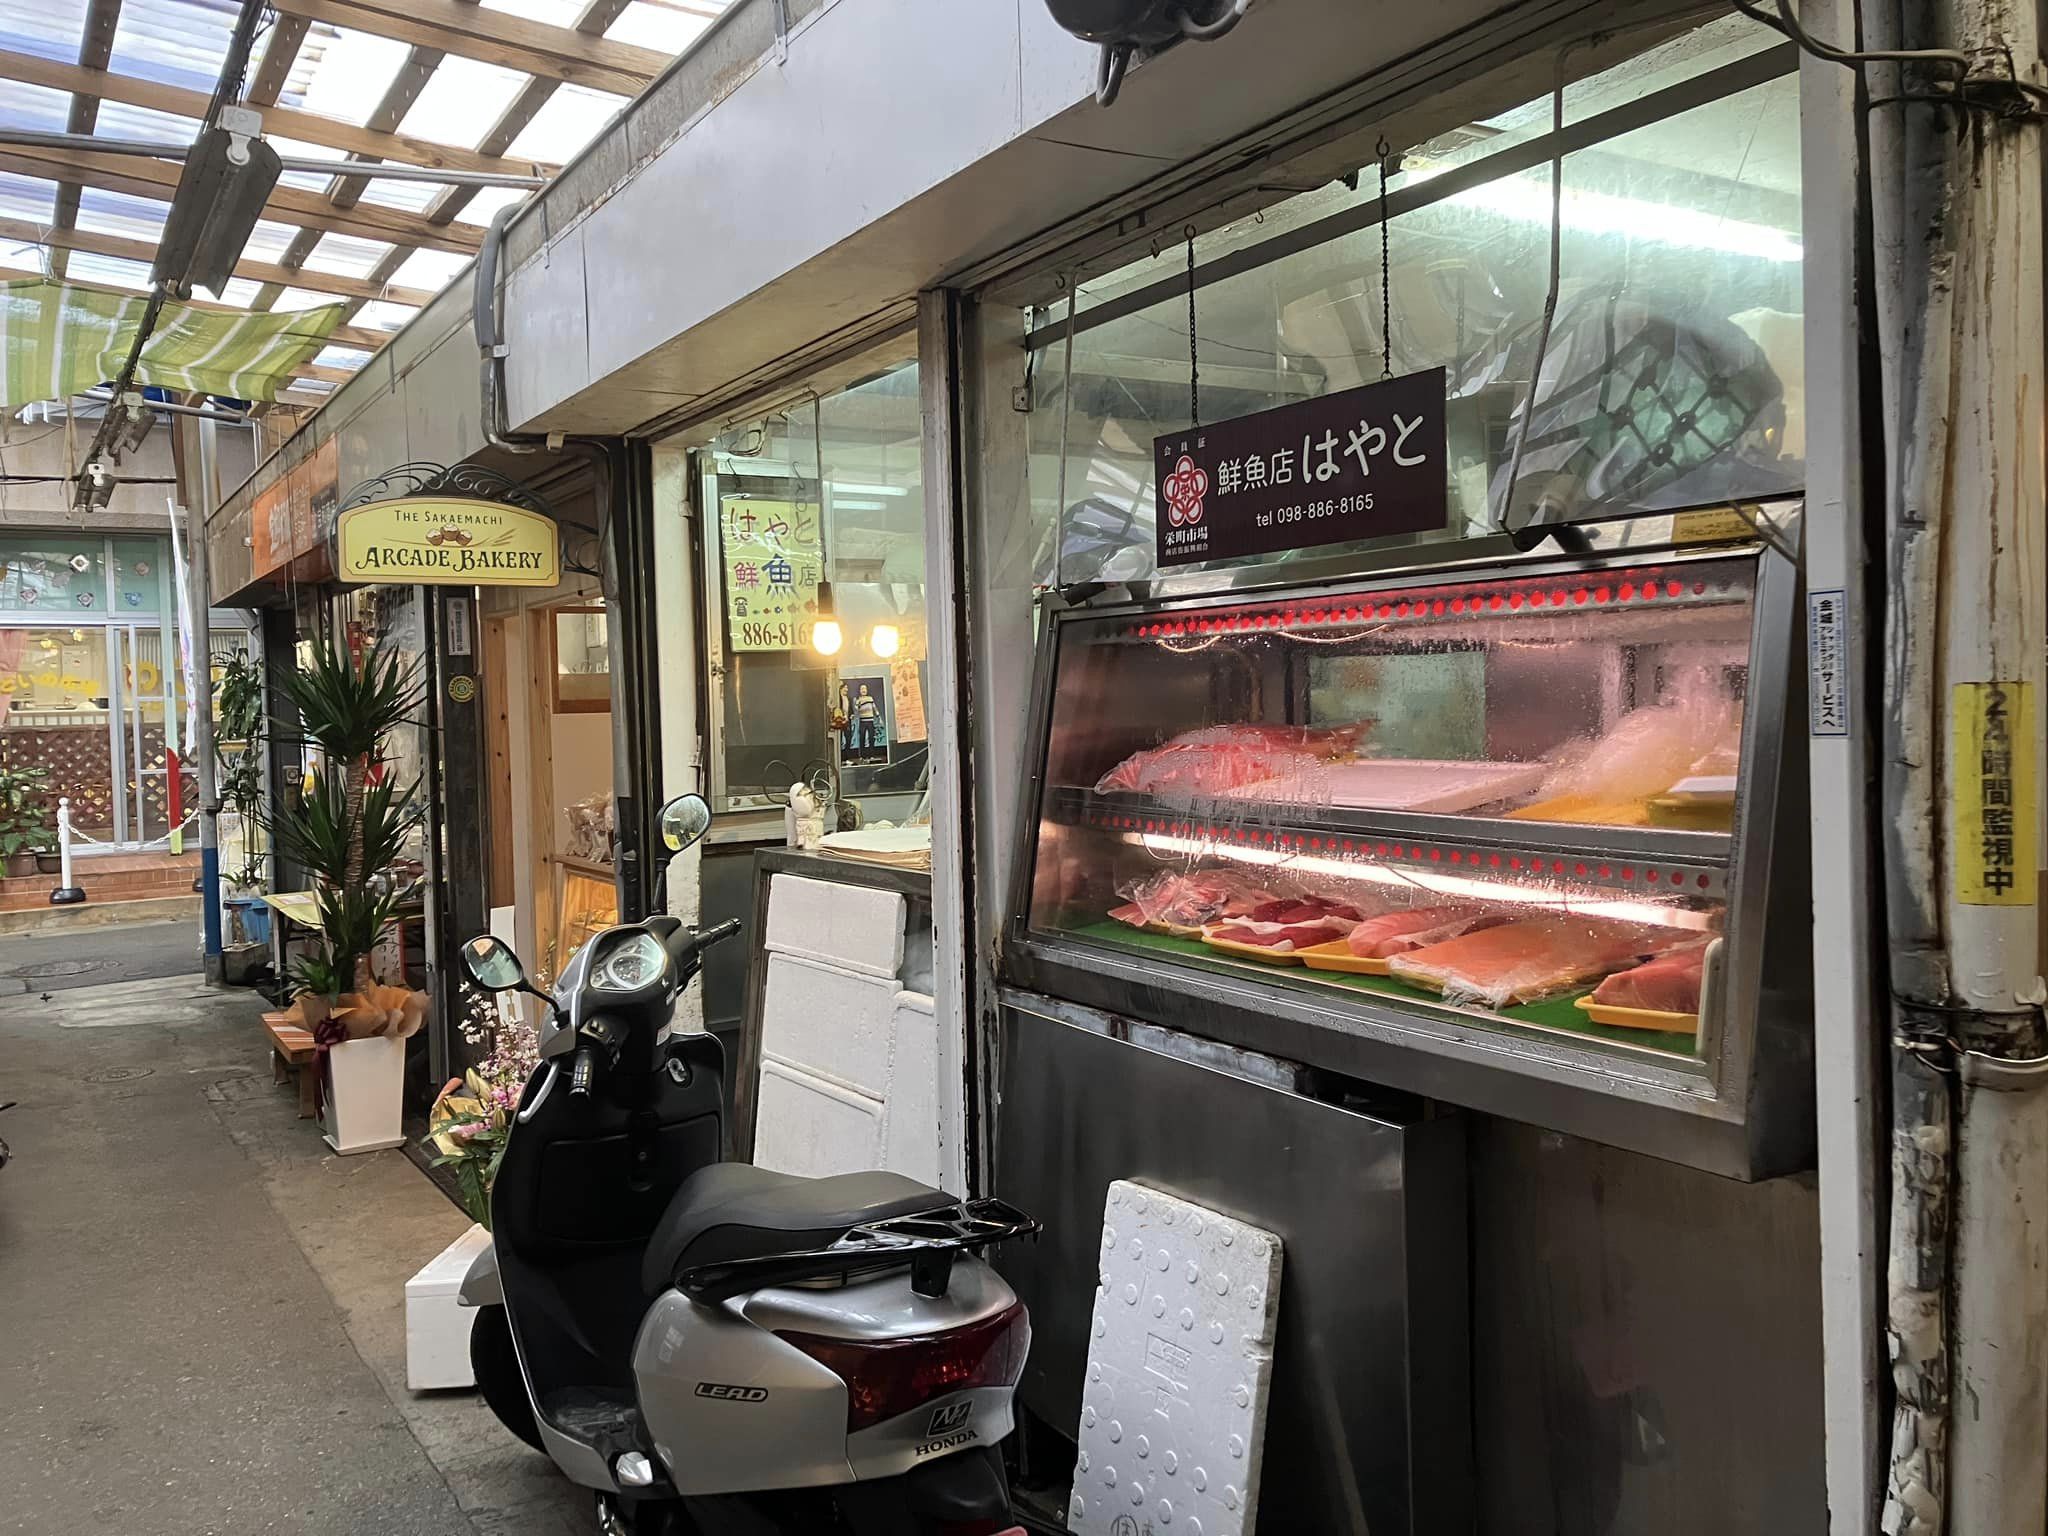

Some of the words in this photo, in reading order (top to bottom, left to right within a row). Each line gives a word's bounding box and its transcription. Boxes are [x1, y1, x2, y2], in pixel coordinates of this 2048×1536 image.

[1217, 447, 1294, 497] 鮮魚店
[1303, 413, 1427, 484] はやと
[394, 509, 419, 522] THE
[424, 510, 503, 526] SAKAEMACHI
[1256, 510, 1273, 528] tel
[1277, 493, 1375, 525] 098-886-8165
[730, 506, 815, 552] はやと
[1164, 526, 1209, 547] 栄町市場
[355, 546, 450, 570] ARCADE
[452, 549, 543, 573] BAKERY
[734, 553, 817, 601] 鮮魚店
[743, 621, 813, 646] 886-816
[1982, 689, 2014, 896] 24時間監視中
[698, 1383, 766, 1401] LEAD
[915, 1429, 978, 1458] HONDA
